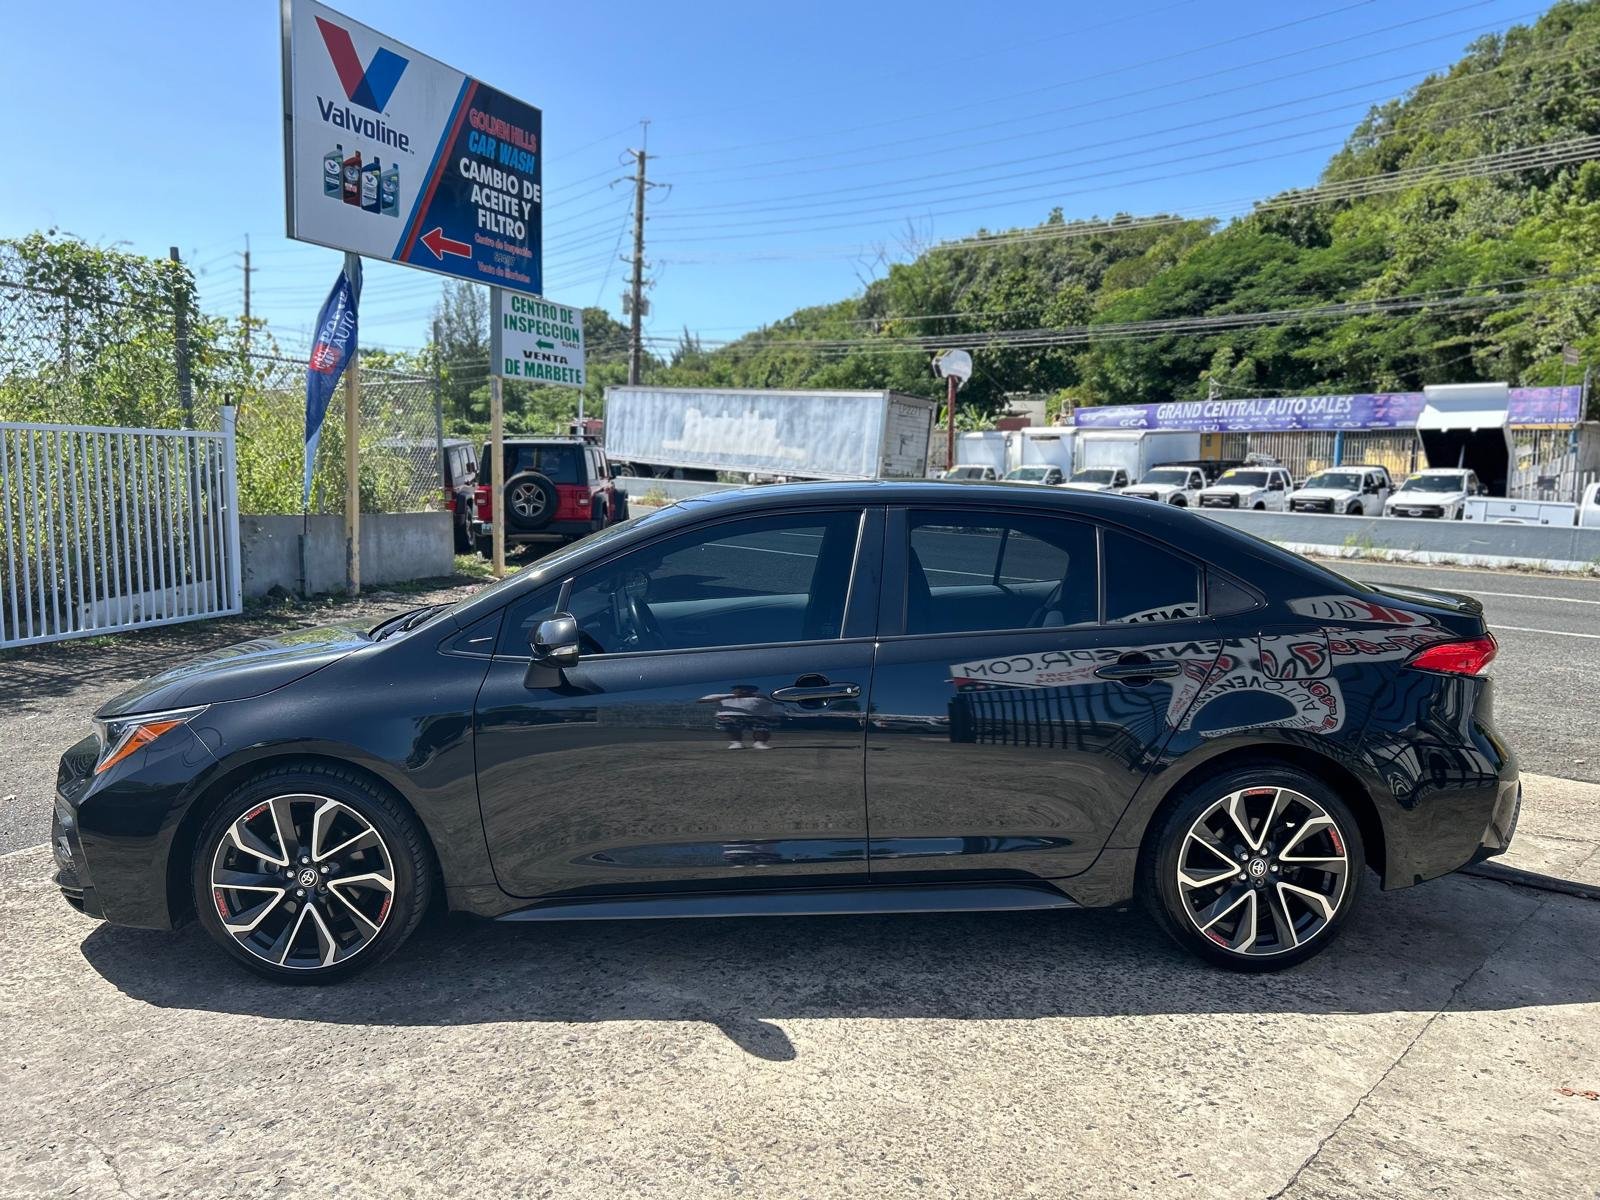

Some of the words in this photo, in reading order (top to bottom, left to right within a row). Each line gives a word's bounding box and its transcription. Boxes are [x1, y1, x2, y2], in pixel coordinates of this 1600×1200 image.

[316, 95, 409, 153] Valvoline
[469, 108, 510, 143] GOLDEN
[510, 125, 537, 153] HILLS
[468, 130, 496, 160] CAR
[500, 142, 535, 175] WASH
[460, 157, 519, 195] CAMBIO
[523, 180, 541, 203] DE
[470, 184, 519, 217] ACEITE
[521, 200, 532, 220] Y
[478, 208, 525, 240] FILTRO
[511, 295, 557, 321] CENTRO
[560, 307, 574, 324] DE
[503, 313, 580, 343] INSPECCION
[505, 358, 520, 375] DE
[524, 361, 582, 385] MARBETE
[523, 350, 568, 365] VENTA
[1119, 418, 1148, 427] GCA
[1157, 404, 1201, 420] GRAND
[1203, 400, 1263, 418] CENTRAL
[1264, 399, 1307, 415] AUTO
[1308, 396, 1354, 414] SALES
